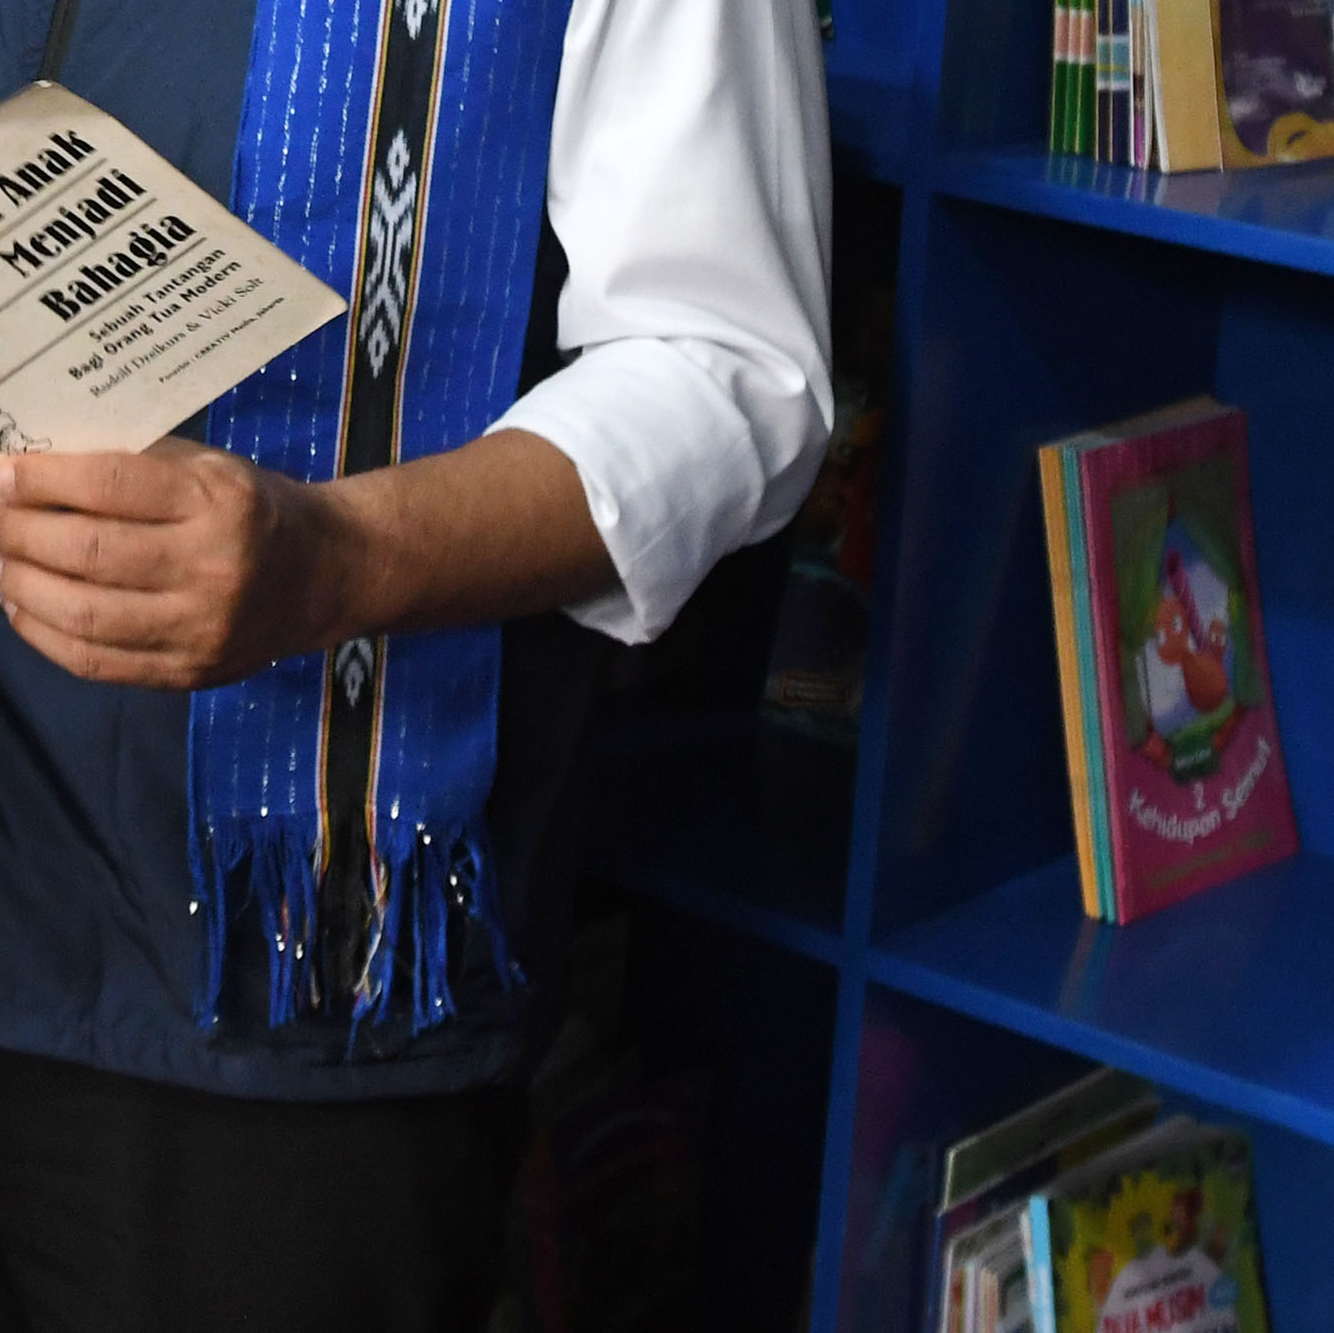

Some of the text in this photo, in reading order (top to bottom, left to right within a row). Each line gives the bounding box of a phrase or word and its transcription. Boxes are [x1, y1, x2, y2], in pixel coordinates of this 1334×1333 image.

[39, 215, 197, 322] Bahagia
[88, 247, 227, 343] Sebuah Tantangan
[186, 321, 202, 333] &
[198, 296, 238, 321] Vicki
[234, 276, 265, 298] Solt
[68, 260, 243, 380] Bagi Orang Tua Modern
[1129, 788, 1221, 846] Kehidupan
